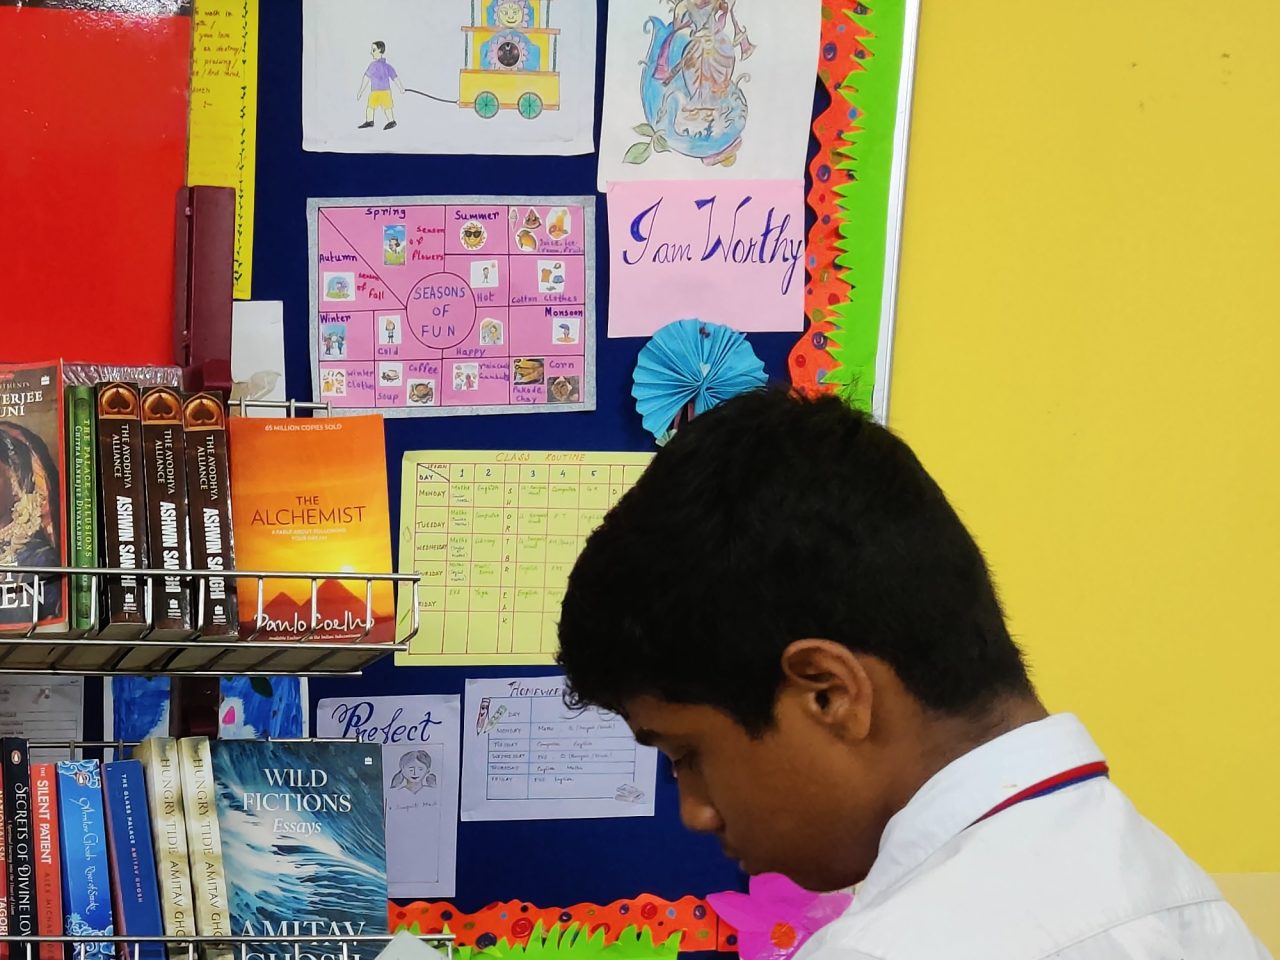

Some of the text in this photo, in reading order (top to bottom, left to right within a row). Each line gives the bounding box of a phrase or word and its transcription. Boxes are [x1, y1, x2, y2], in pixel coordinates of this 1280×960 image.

[455, 210, 499, 220] Summer
[622, 196, 803, 295] I am Worthy
[320, 252, 358, 262] Autumn
[413, 286, 466, 300] SEASONS
[477, 292, 494, 302] Hot
[320, 314, 351, 324] Winter
[432, 303, 450, 318] OF
[544, 306, 583, 317] Monsoon
[421, 324, 456, 338] FUN
[378, 347, 398, 355] Cold
[456, 347, 486, 356] Happy
[409, 362, 439, 374] Coffee
[549, 360, 574, 369] Corn
[112, 434, 122, 478] ALLIANCE
[121, 424, 132, 488] THE AYODHYA
[155, 440, 166, 484] ALLIANCE
[164, 430, 176, 494] THE AYODHYA
[496, 453, 530, 462] CLASS
[486, 468, 492, 476] 2
[531, 470, 536, 478] 3
[560, 470, 566, 478] 4
[296, 496, 320, 506] THE
[160, 502, 178, 546] ASHWIN
[251, 506, 366, 526] ALCHEMIST
[116, 496, 137, 587] ASHWIN SANHI
[203, 508, 225, 599] ASHWIN SAGHI
[332, 701, 442, 745] Prefect
[264, 768, 328, 788] WILD
[37, 779, 50, 820] SILENT
[242, 792, 352, 812] FICTIONS
[160, 758, 182, 907] HUNGRY TIDE AMITAV
[193, 758, 220, 908] HUNGRY TIDE AMITAV
[272, 818, 322, 836] Essays
[39, 823, 52, 864] PATIENT
[240, 920, 366, 946] AMITAV
